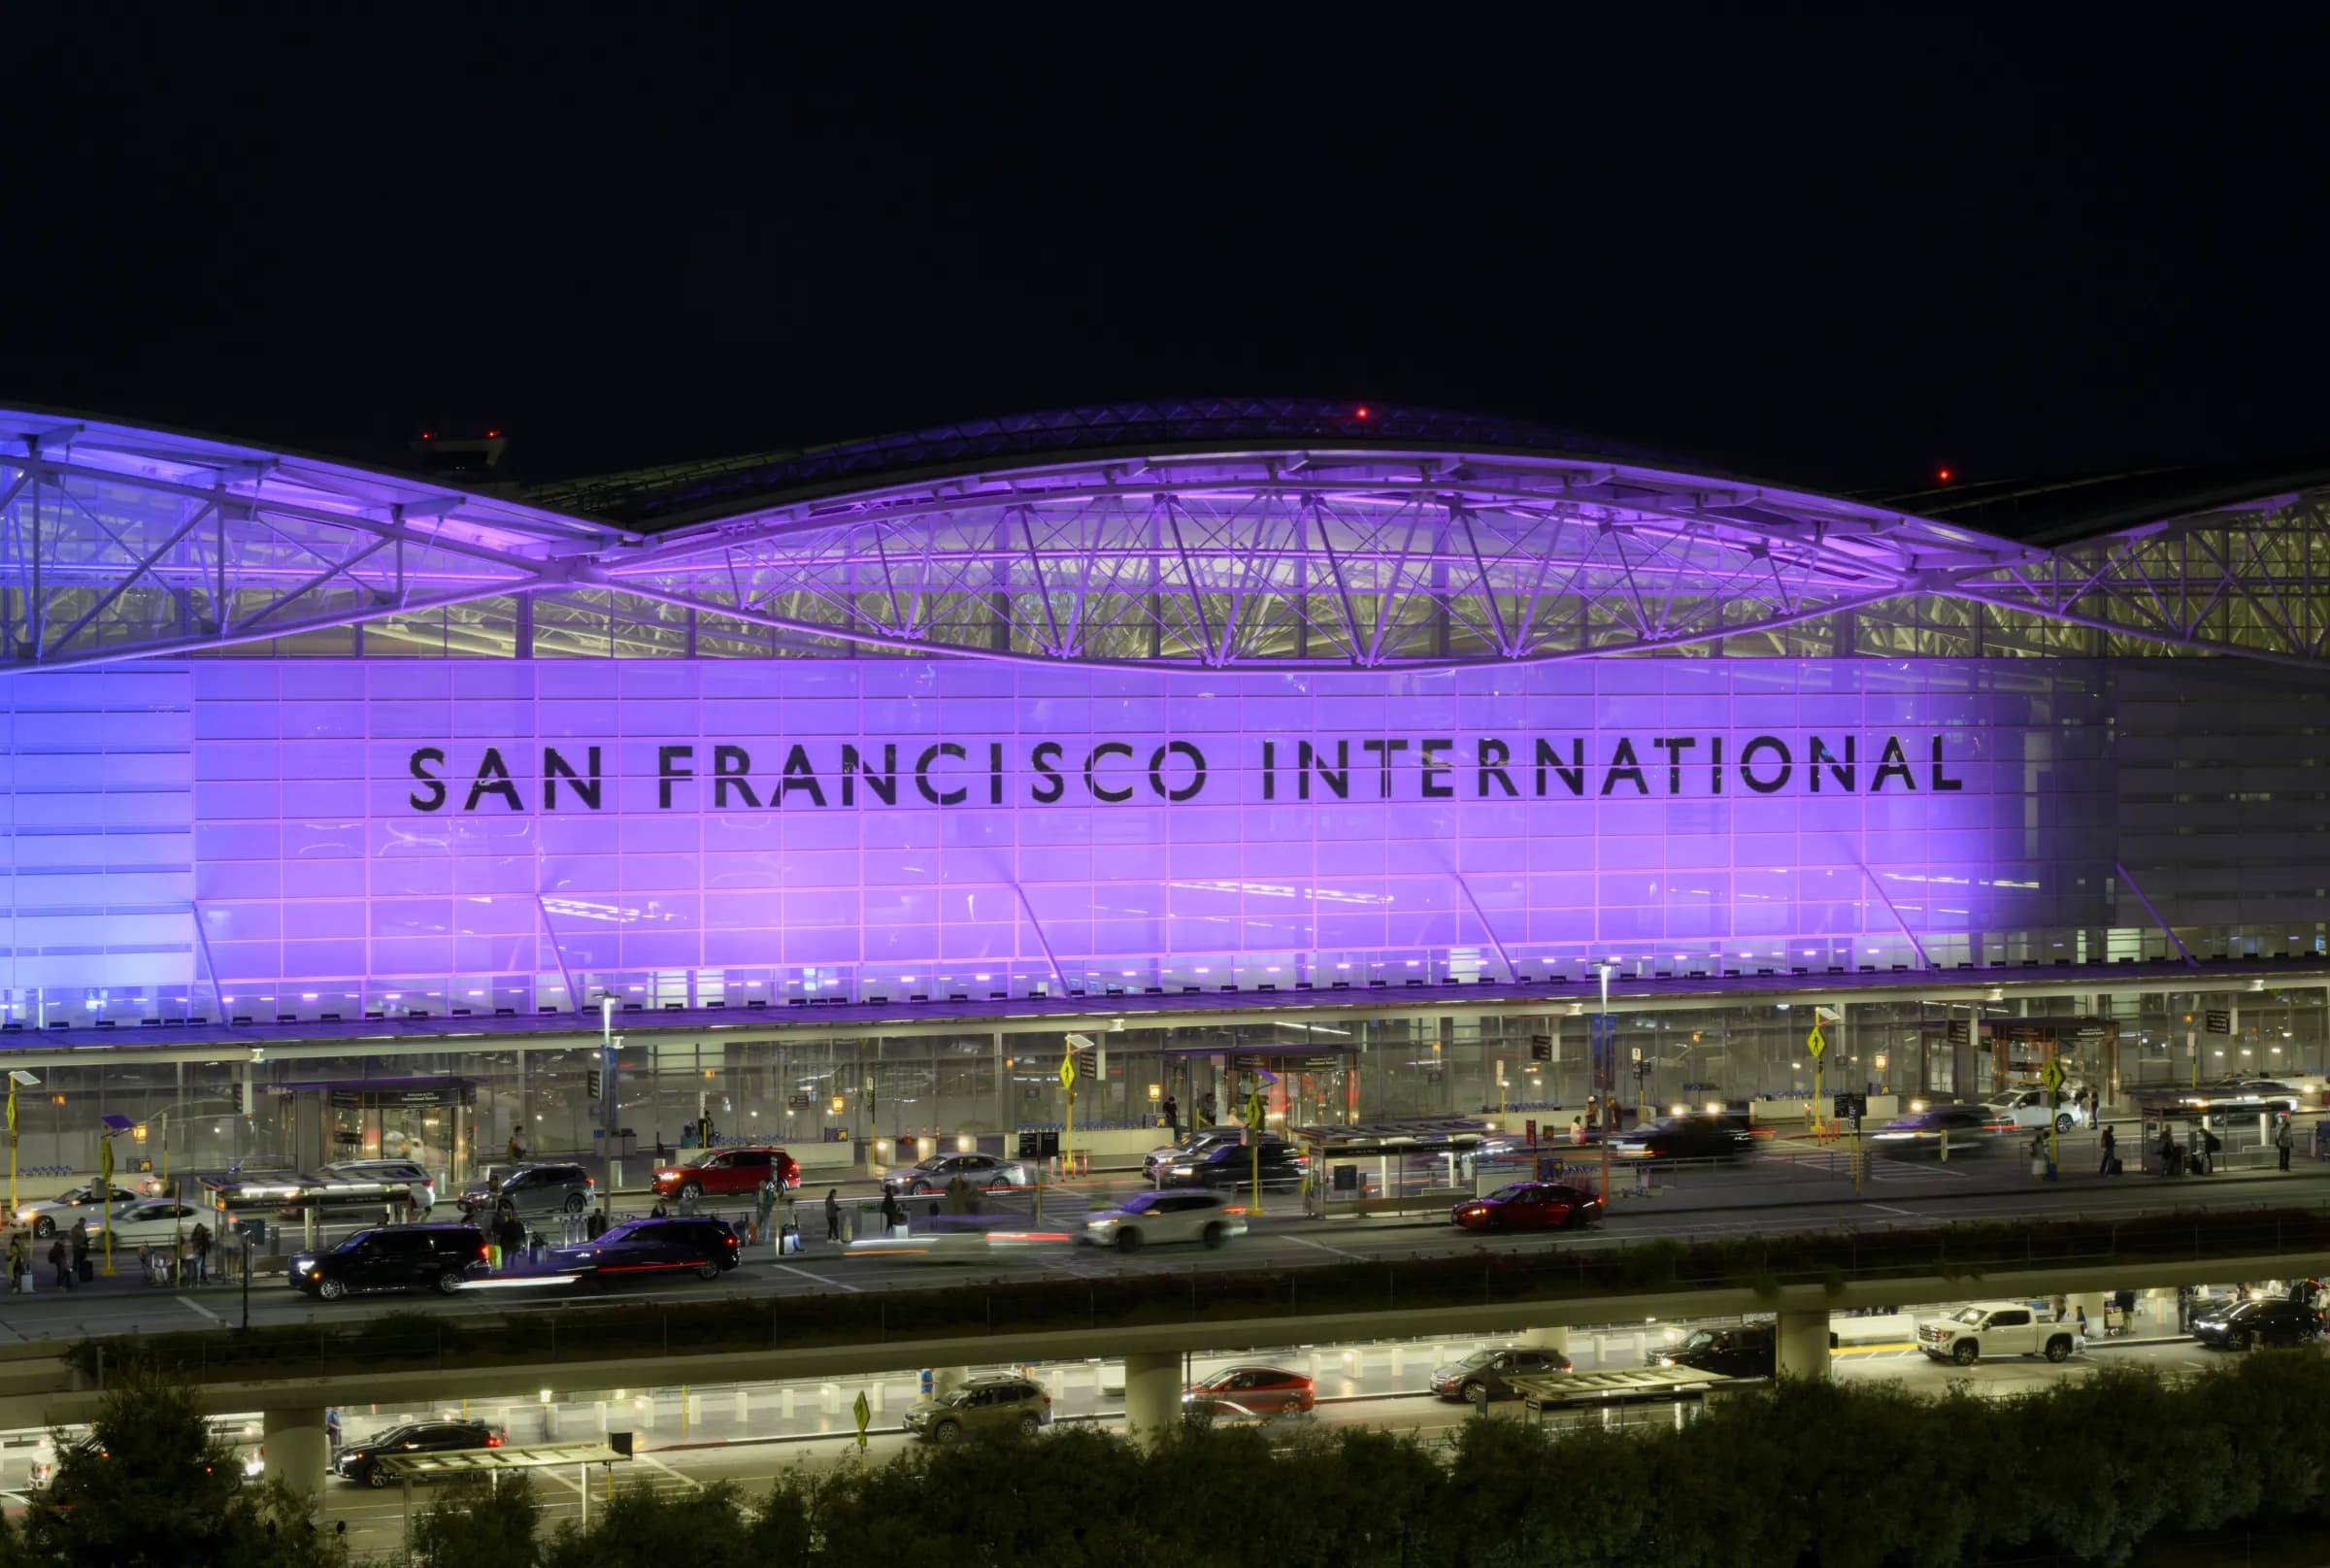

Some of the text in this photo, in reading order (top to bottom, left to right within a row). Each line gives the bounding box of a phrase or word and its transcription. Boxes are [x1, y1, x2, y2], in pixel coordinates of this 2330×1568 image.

[409, 734, 1963, 812] SAN FRANCISCO INTERNATIONAL
